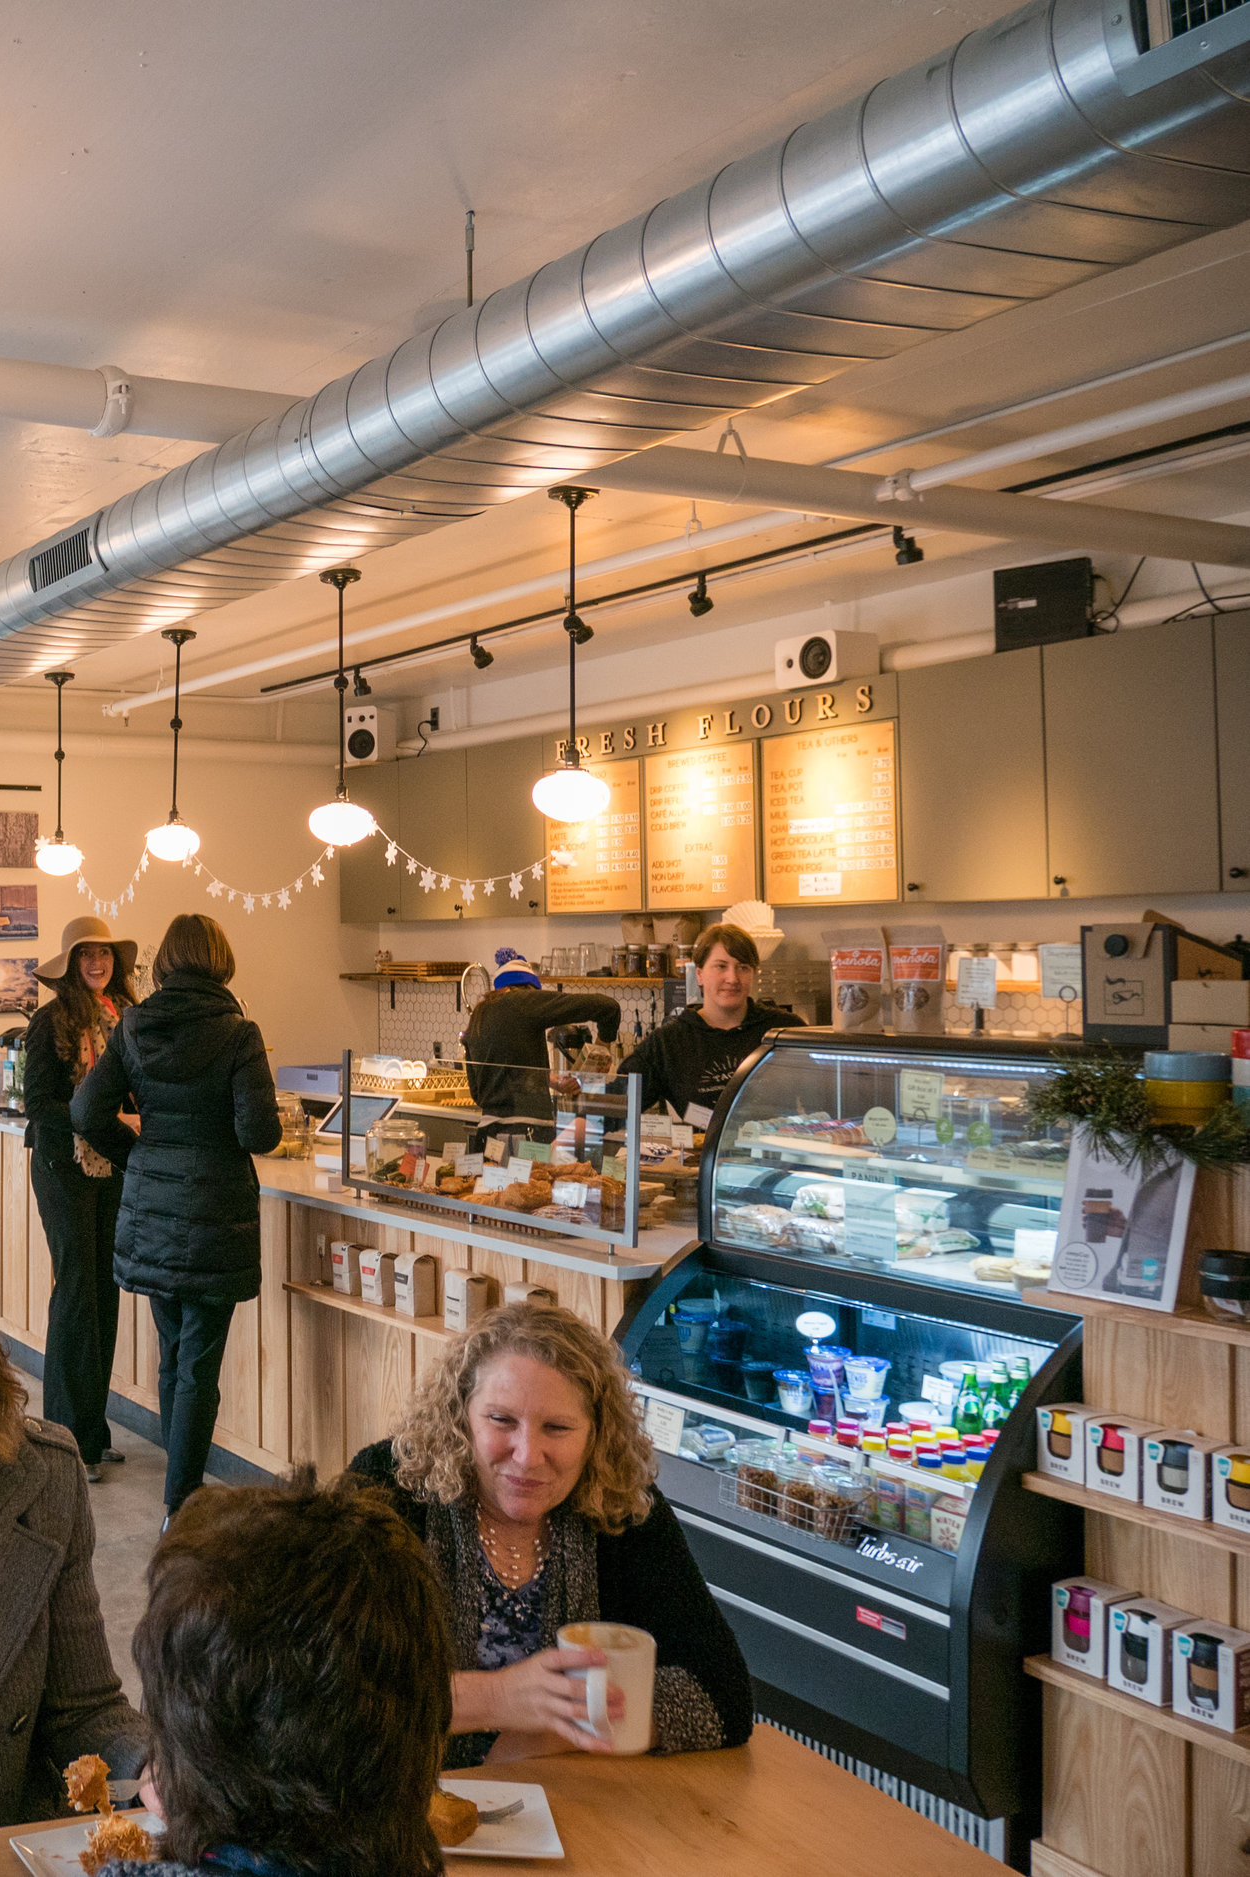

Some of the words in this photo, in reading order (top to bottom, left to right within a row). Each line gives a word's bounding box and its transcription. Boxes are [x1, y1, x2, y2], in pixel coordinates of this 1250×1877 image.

[555, 722, 667, 762] FRESH
[696, 684, 874, 740] FLOURS
[892, 951, 937, 965] ranola
[851, 1170, 886, 1184] PANINI
[1050, 1461, 1068, 1473] BREW
[1100, 1478, 1120, 1489] BREW
[1161, 1496, 1185, 1508] BREW
[935, 1516, 961, 1530] WINTER
[1066, 1652, 1087, 1665] BREW
[1123, 1680, 1144, 1693] BREW
[1190, 1706, 1215, 1719] BREW
